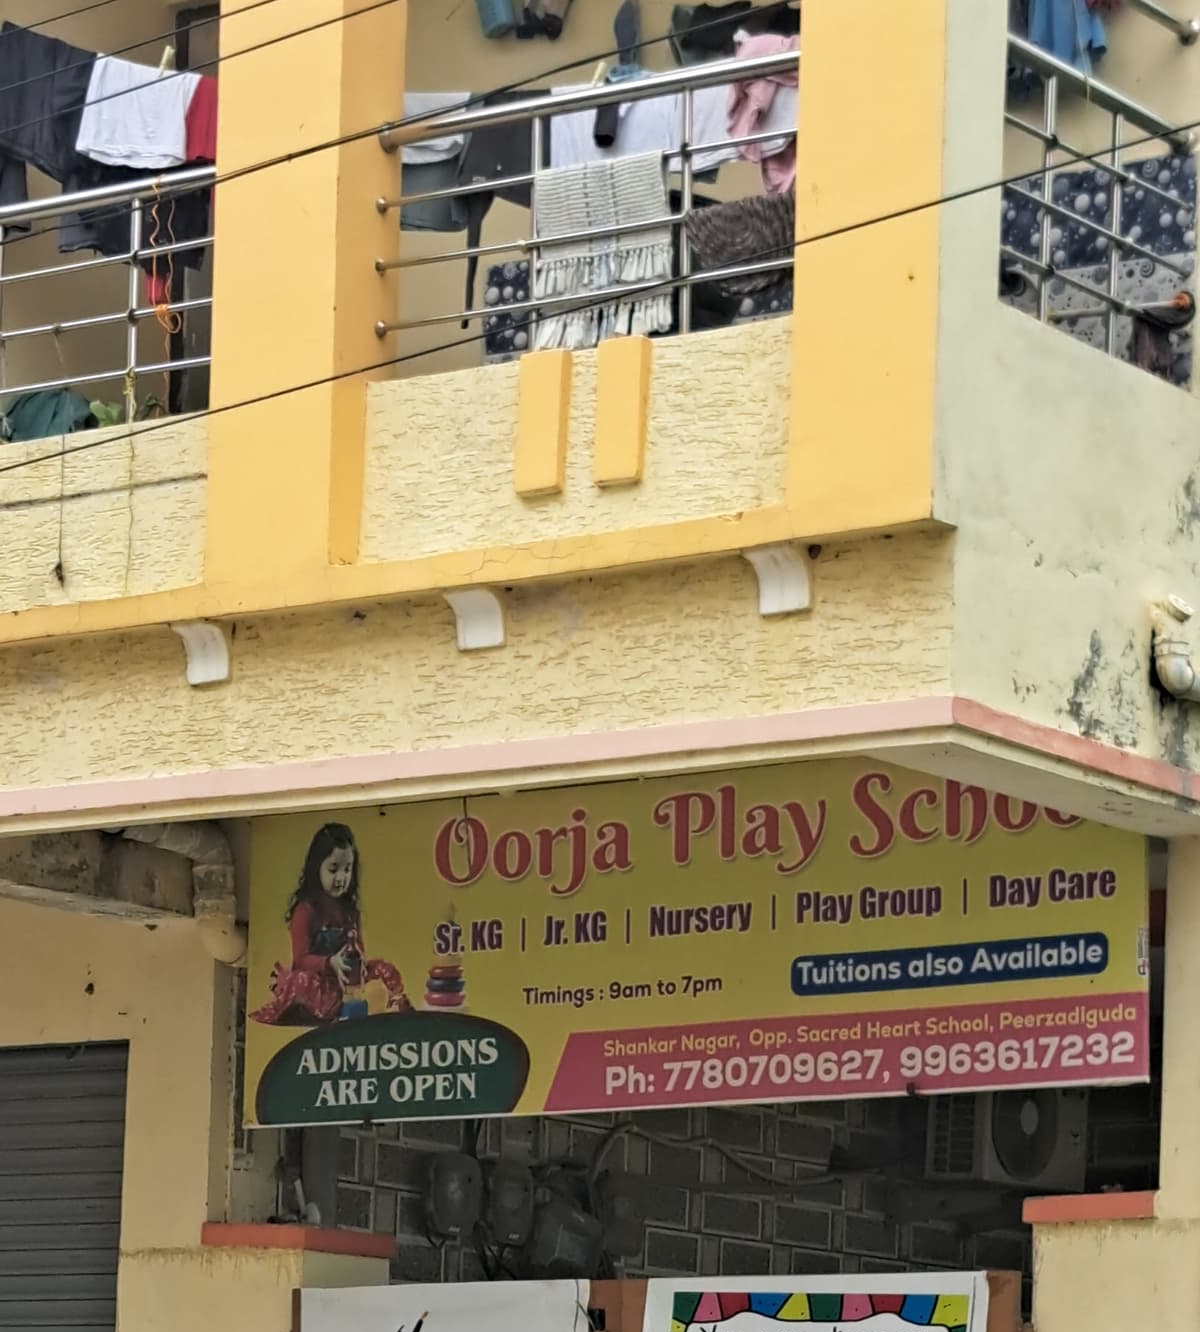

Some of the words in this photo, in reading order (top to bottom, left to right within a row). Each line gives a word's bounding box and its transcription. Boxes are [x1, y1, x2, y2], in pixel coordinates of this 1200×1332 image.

[434, 808, 634, 897] Oorja
[653, 785, 827, 874] Play
[848, 772, 1083, 858] Scho
[436, 924, 464, 955] Sr.
[471, 919, 503, 951] KG
[544, 915, 568, 947] Jr.
[575, 912, 607, 944] KG
[649, 901, 752, 938] Nursery
[796, 889, 852, 925] Play
[859, 885, 942, 920] Group
[989, 875, 1041, 908] Day
[1048, 868, 1116, 901] Care
[797, 955, 901, 986] Tuitions
[908, 952, 963, 978] also
[970, 940, 1103, 974] Available
[523, 985, 594, 1008] Timings
[609, 982, 651, 1000] 9am
[657, 981, 676, 997] to
[681, 976, 723, 998] 7pm
[604, 1036, 676, 1057] Shankar
[681, 1031, 740, 1054] Nagar,
[749, 1028, 792, 1049] Opp.
[796, 1023, 861, 1045] Sacred
[867, 1018, 922, 1039] Heart
[926, 1014, 993, 1037] School,
[1000, 1003, 1136, 1031] Peerzadiguda
[296, 1038, 498, 1075] ADMISSIONS
[605, 1065, 655, 1095] Ph:
[662, 1047, 892, 1091] 7780709627,
[900, 1032, 1136, 1078] 9963617232
[313, 1079, 378, 1107] ARE
[389, 1072, 477, 1102] OPEN
